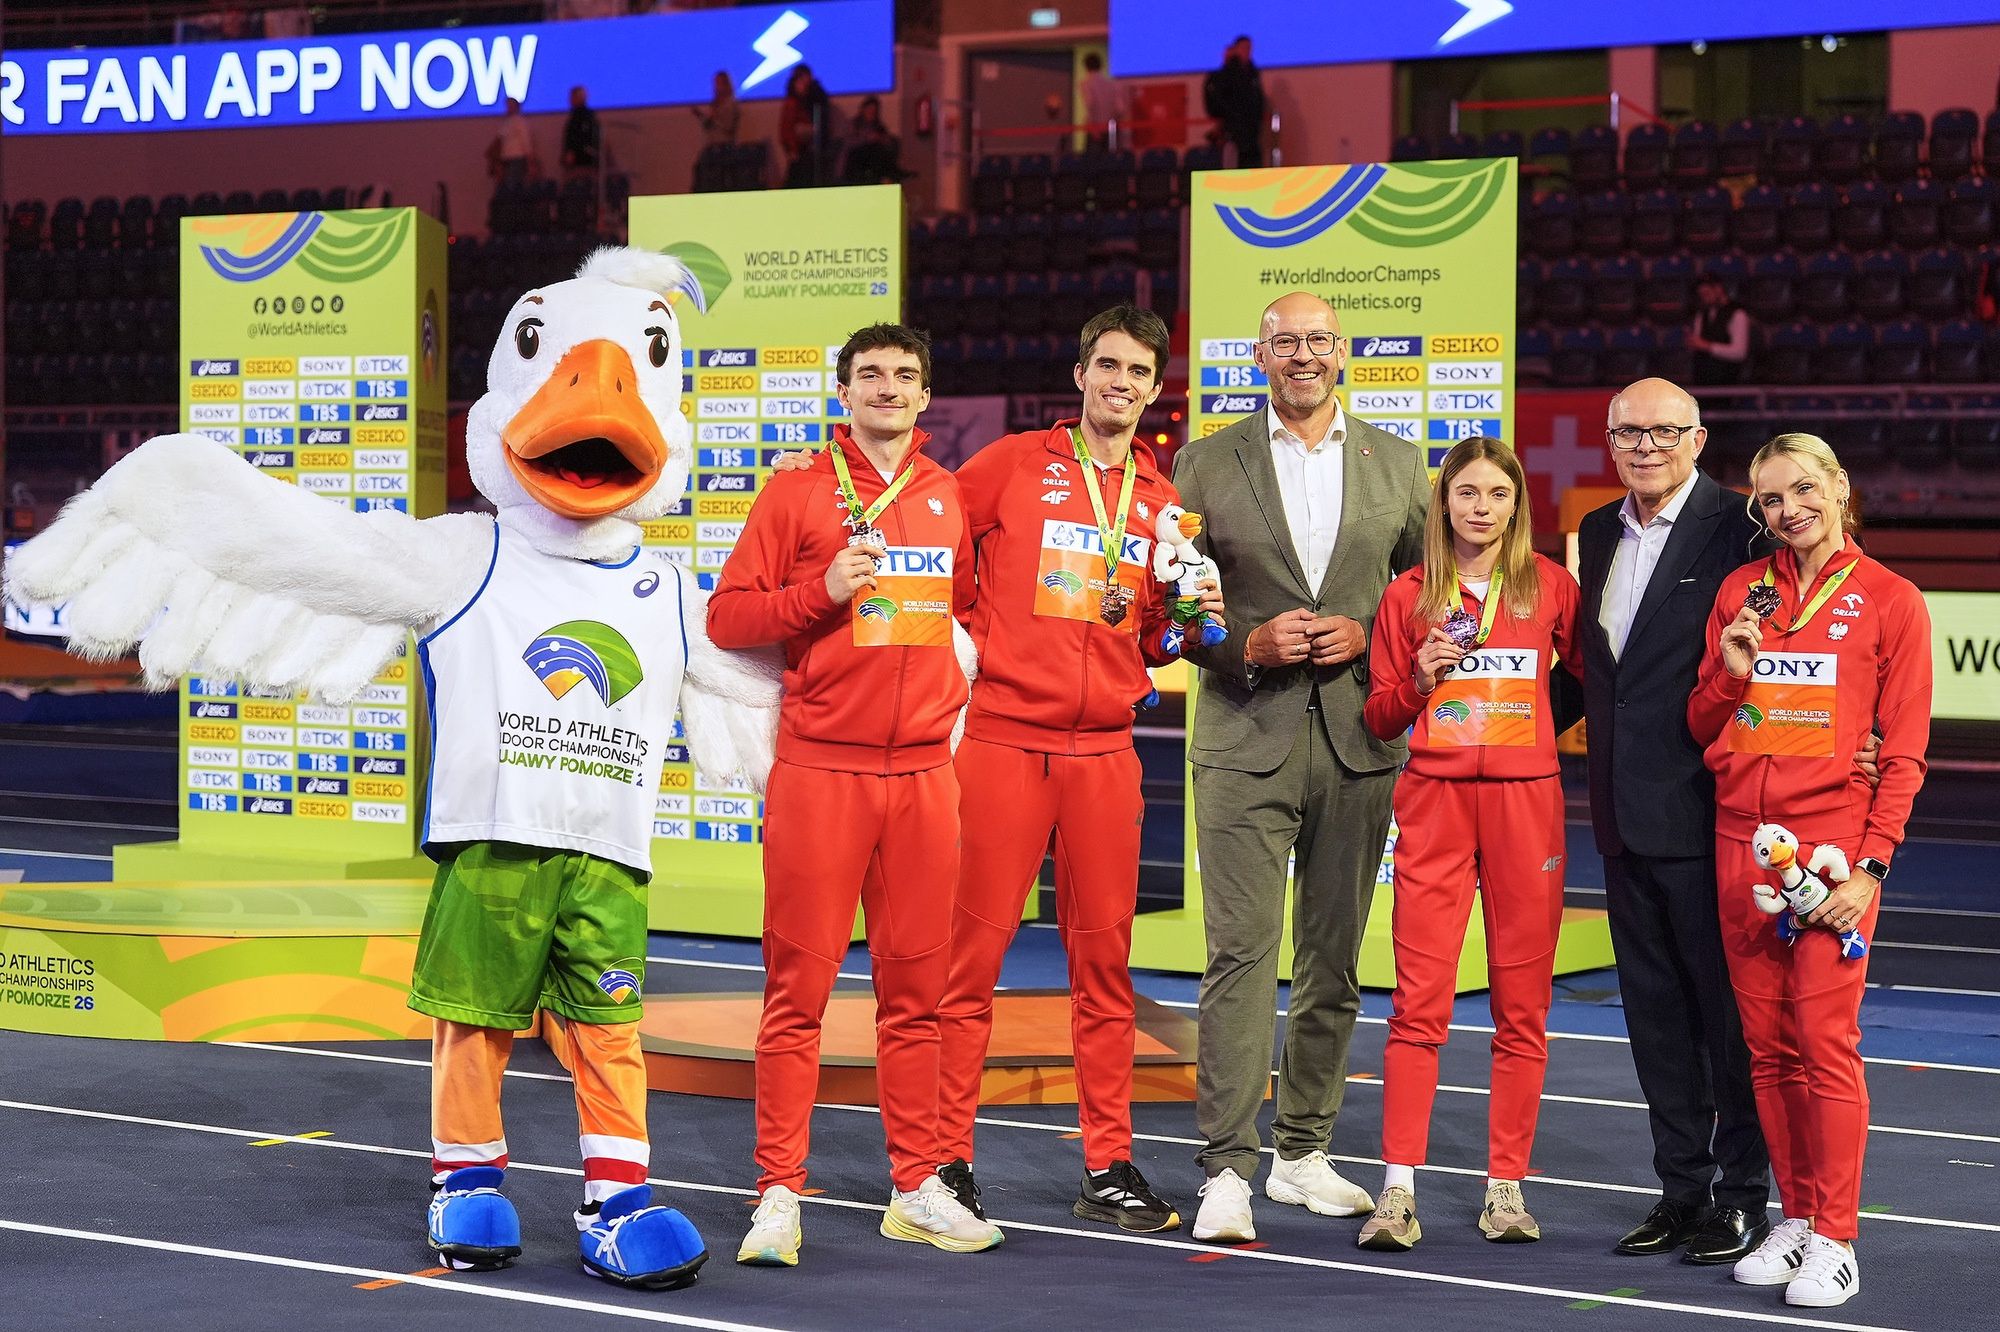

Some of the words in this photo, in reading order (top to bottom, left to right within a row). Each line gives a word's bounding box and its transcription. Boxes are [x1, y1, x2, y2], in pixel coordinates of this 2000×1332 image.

[47, 55, 187, 125] FAN
[204, 47, 343, 120] APP
[361, 35, 539, 113] NOW
[745, 251, 799, 266] WORLD
[804, 248, 888, 264] ATHLETICS
[744, 269, 788, 281] INDOOR
[791, 266, 888, 280] CHAMPIONSHIPS
[1260, 265, 1440, 285] #WorldIndoorChamps
[744, 285, 797, 299] KUJAWY
[801, 283, 866, 297] POMORZE
[870, 283, 887, 295] 26
[1318, 294, 1422, 312] athletics.org
[247, 322, 347, 338] @WorldAthletics
[1378, 340, 1410, 354] asics
[1432, 337, 1499, 353] SEIKO
[764, 350, 818, 364] SEIKO
[246, 360, 292, 374] SEIKO
[304, 361, 344, 371] SONY
[368, 359, 402, 371] TDK
[1215, 367, 1253, 388] TBS
[1354, 367, 1419, 382] SEIKO
[1436, 368, 1492, 379] SONY
[312, 383, 345, 395] TDK
[367, 380, 397, 397] TBS
[701, 376, 754, 390] SEIKO
[767, 377, 814, 387] SONY
[192, 384, 237, 397] SEIKO
[249, 385, 288, 395] SONY
[704, 403, 749, 413] SONY
[778, 401, 814, 414] TDK
[1358, 397, 1413, 408] SONY
[1449, 393, 1494, 409] TDK
[195, 408, 234, 419] SONY
[256, 407, 288, 419] TDK
[310, 404, 340, 421] TBS
[255, 428, 284, 445] TBS
[357, 429, 405, 443] SEIKO
[714, 426, 750, 439] TDK
[773, 424, 808, 441] TBS
[1444, 420, 1484, 440] TBS
[300, 453, 348, 466] SEIKO
[360, 455, 400, 464] SONY
[710, 449, 744, 467] TBS
[304, 478, 344, 488] SONY
[370, 477, 402, 489] TDK
[1042, 478, 1070, 486] ORLEN
[1041, 490, 1071, 504] 4F
[700, 502, 751, 513] SEIKO
[703, 528, 743, 537] SON
[1076, 527, 1142, 561] TK
[884, 551, 946, 573] TDK
[1832, 606, 1860, 617] ORLEN
[1753, 659, 1824, 677] ONY
[244, 705, 291, 720] SEIKO
[302, 709, 343, 720] SONY
[369, 709, 402, 725] TDK
[190, 726, 236, 740] SEIKO
[248, 729, 287, 740] SONY
[313, 732, 343, 745] TDK
[364, 732, 395, 750] TBS
[193, 752, 232, 761] SONY
[257, 753, 287, 766] TDK
[307, 754, 338, 771] TBS
[499, 749, 557, 769] UJAWY
[560, 756, 634, 784] POMORZE
[203, 773, 232, 786] TDK
[253, 774, 282, 791] TBS
[355, 782, 403, 797] SEIKO
[198, 793, 228, 811] TBS
[715, 801, 746, 815] TDK
[299, 802, 346, 817] SEIKO
[358, 808, 399, 818] SONY
[707, 823, 740, 842] TBS
[8, 954, 96, 977] ATHLETICS
[0, 971, 95, 993] CHAMPIONSHIPS
[7, 988, 70, 1008] POMORZE
[75, 996, 94, 1010] 26
